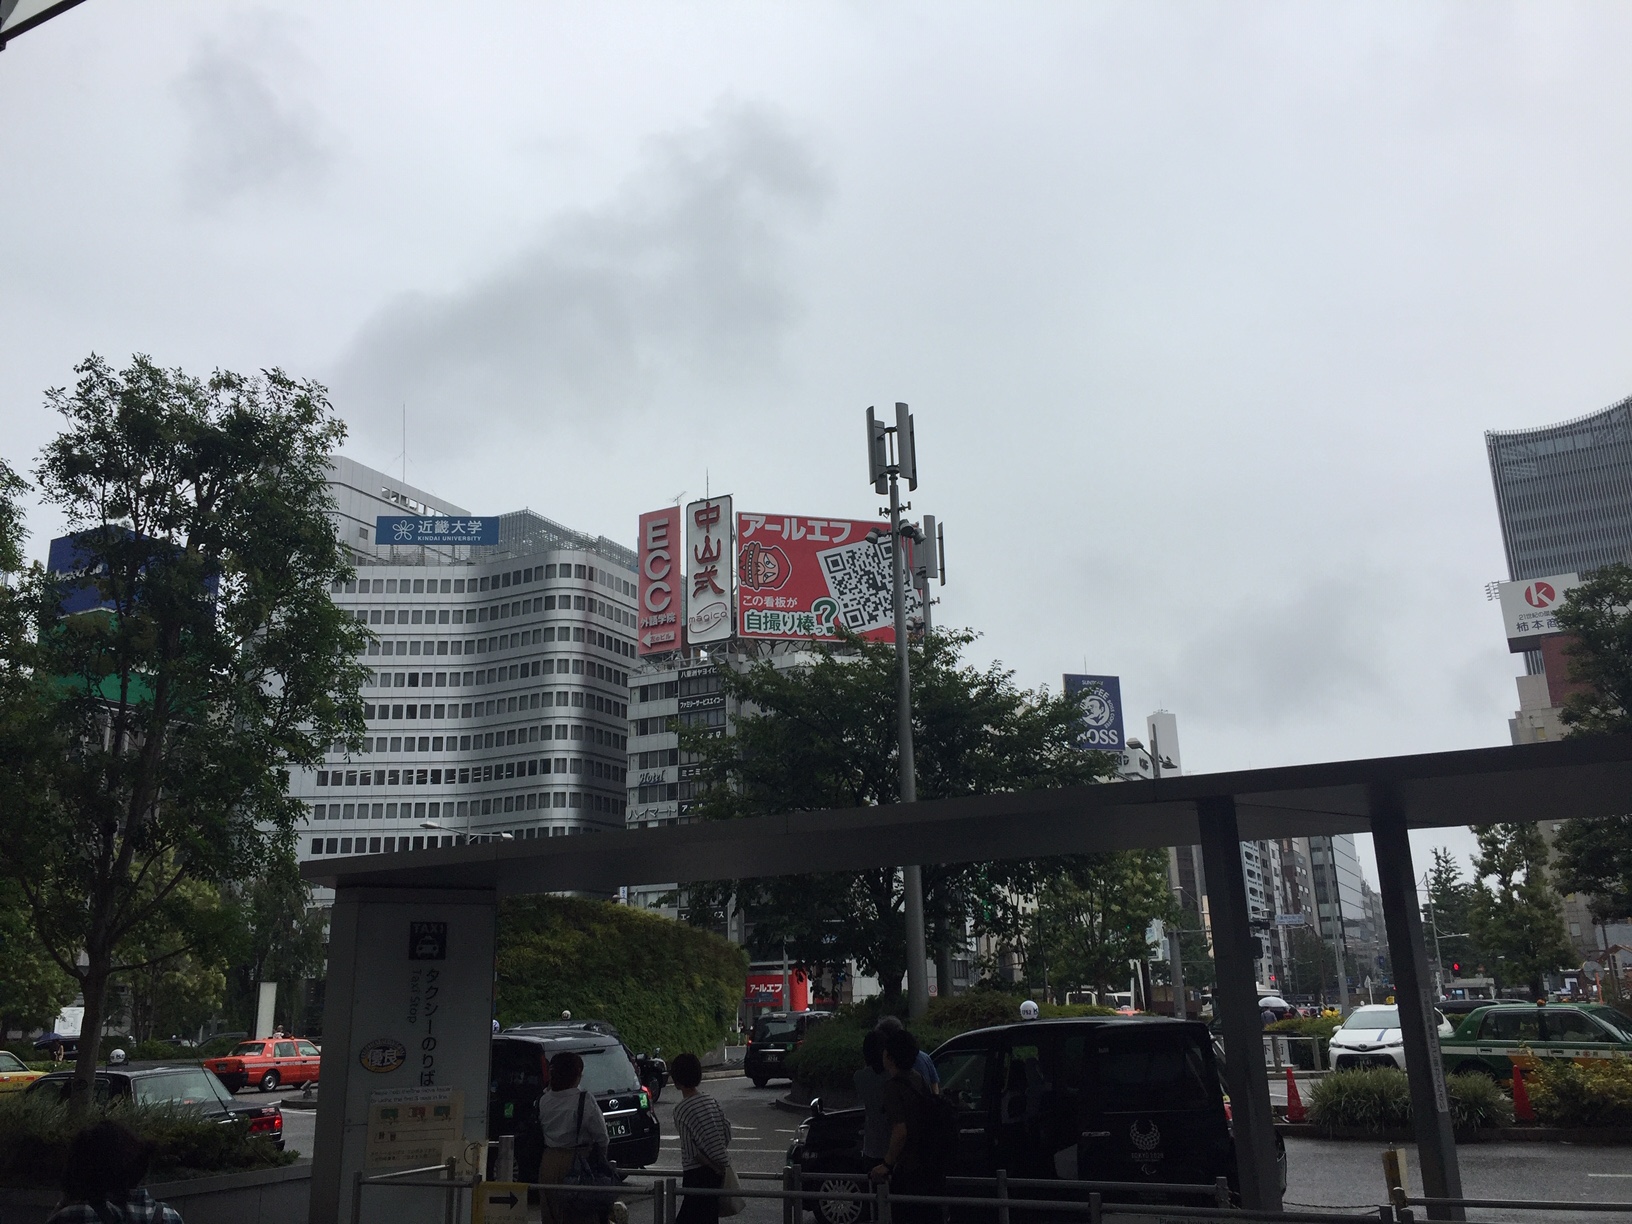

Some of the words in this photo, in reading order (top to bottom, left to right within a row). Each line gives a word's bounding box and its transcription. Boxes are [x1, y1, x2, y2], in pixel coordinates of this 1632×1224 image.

[417, 520, 483, 534] 近畿大学
[741, 514, 852, 544] アールエフ
[692, 501, 726, 599] 中山式
[644, 517, 672, 613] ECC
[742, 595, 798, 608] この看板が
[640, 612, 677, 628] 外語学院
[681, 666, 718, 679] 八重洲ヤヨイビ
[639, 768, 666, 784] Hotel
[627, 804, 677, 820] ハイマート
[413, 923, 444, 934] TAXI
[409, 969, 422, 993] Taxi
[749, 983, 783, 993] アールエフ
[406, 995, 421, 1024] Stop
[419, 969, 440, 1087] タクシーのりば
